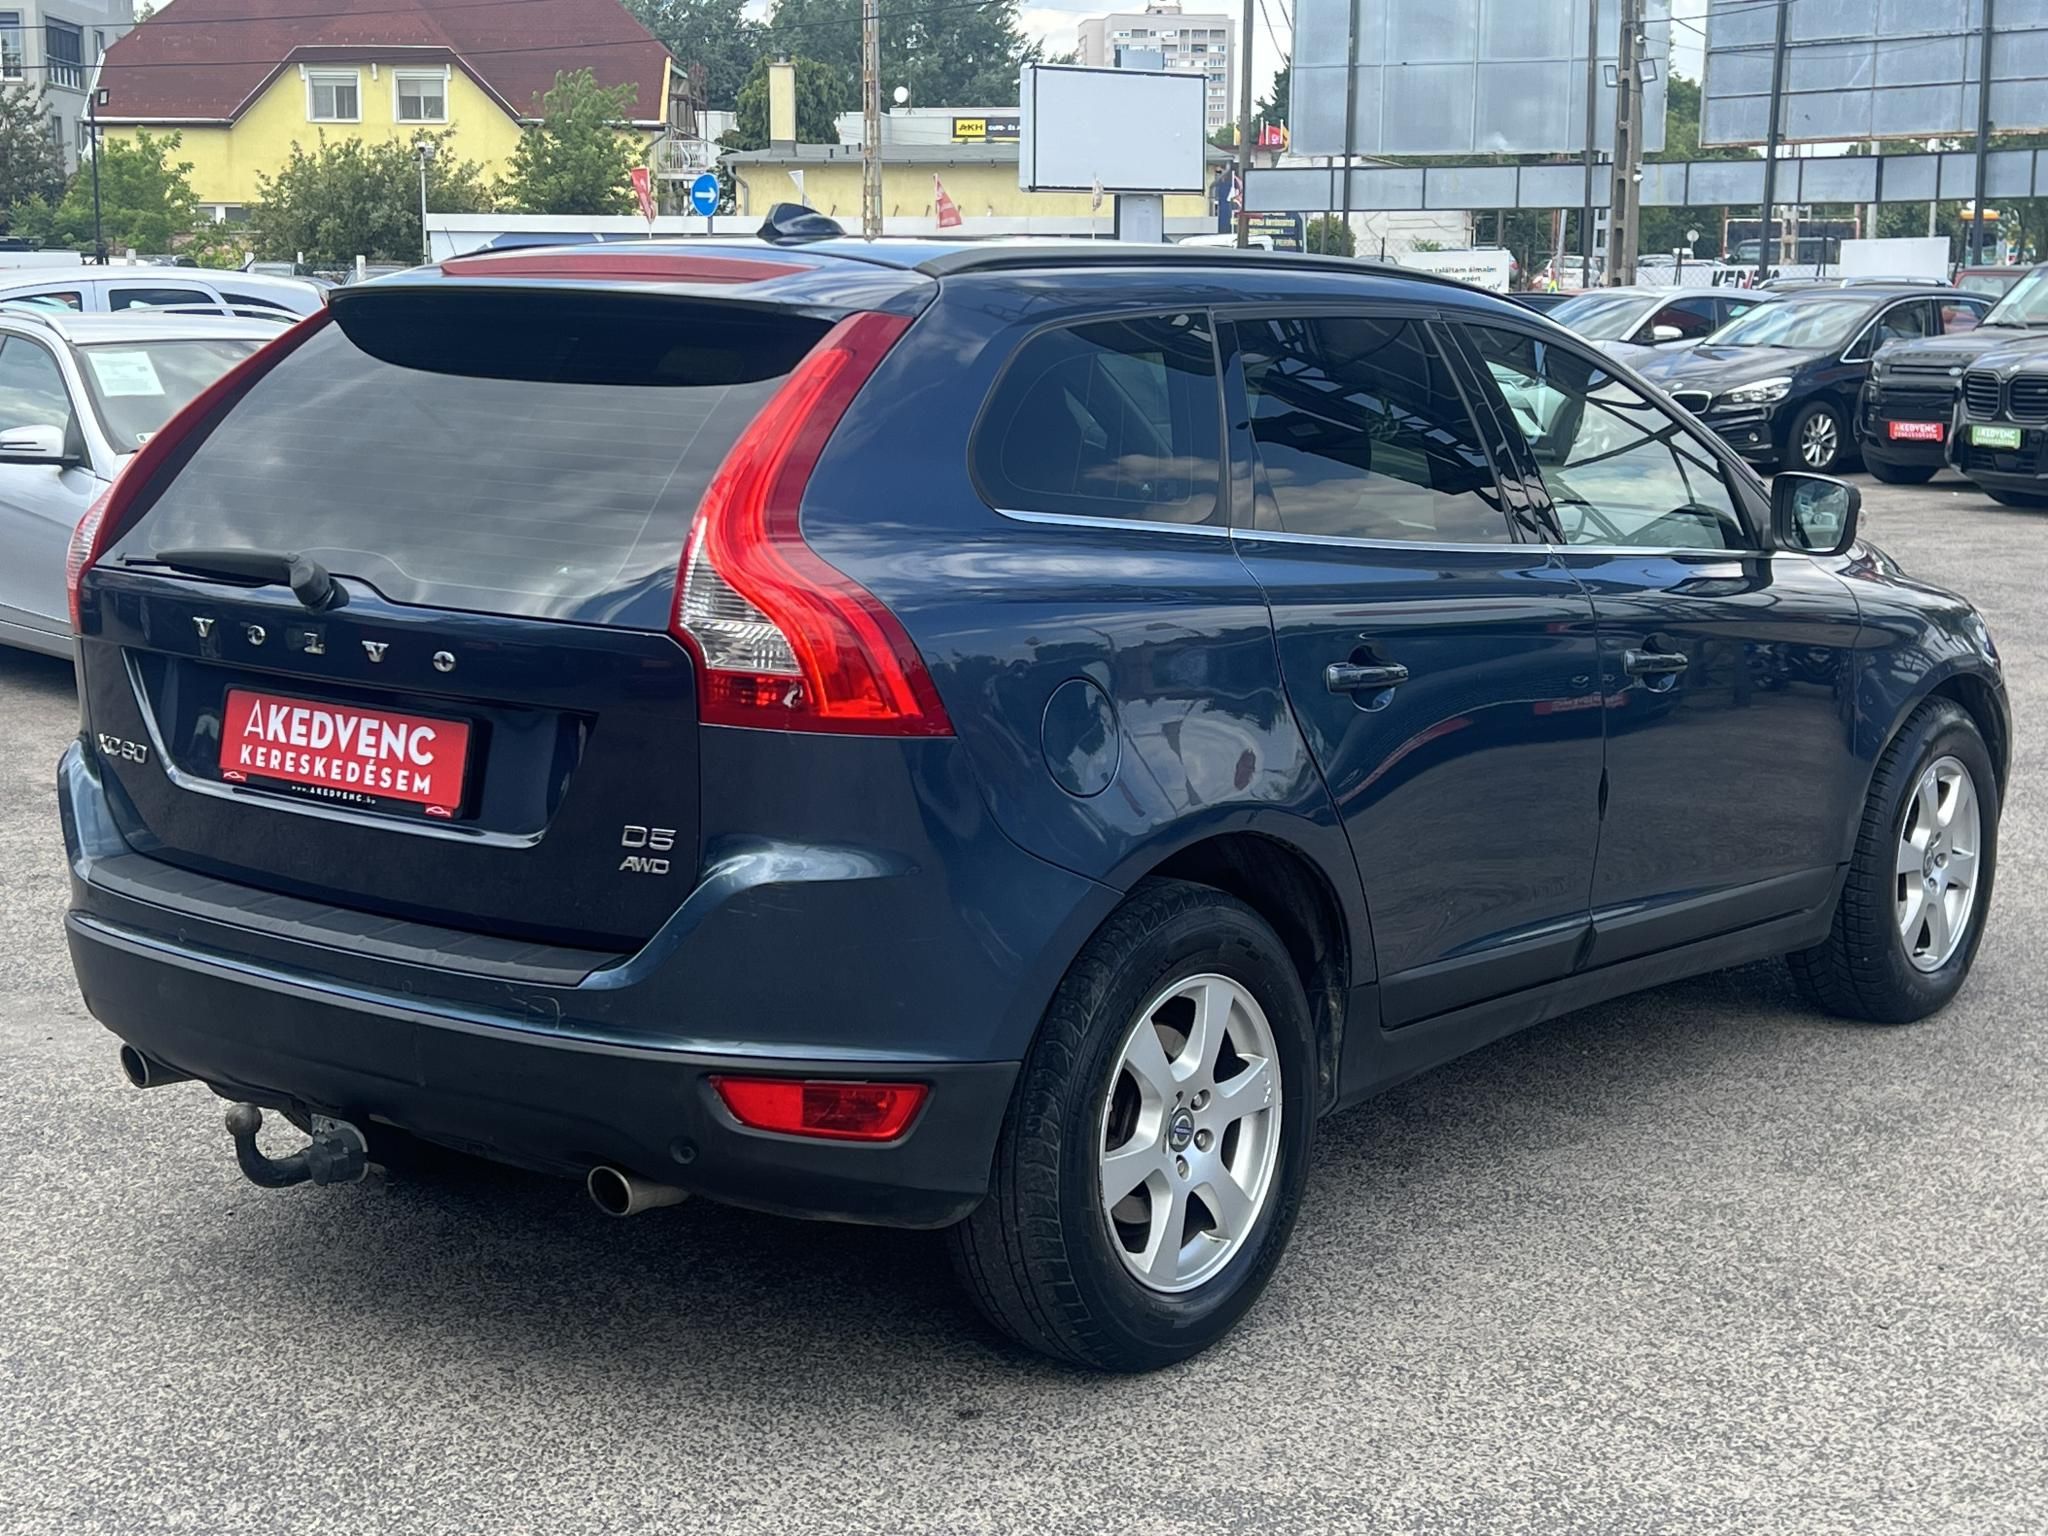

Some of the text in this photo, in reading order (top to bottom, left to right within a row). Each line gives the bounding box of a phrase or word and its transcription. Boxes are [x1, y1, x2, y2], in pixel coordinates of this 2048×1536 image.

[1711, 269, 1780, 289] KEDVE
[193, 616, 456, 672] VOLVO
[243, 699, 437, 766] AKEDVENC
[98, 733, 148, 764] XC60
[239, 743, 432, 795] KERESKEDÉSEM
[621, 825, 677, 851] D5
[618, 856, 670, 874] AWD
